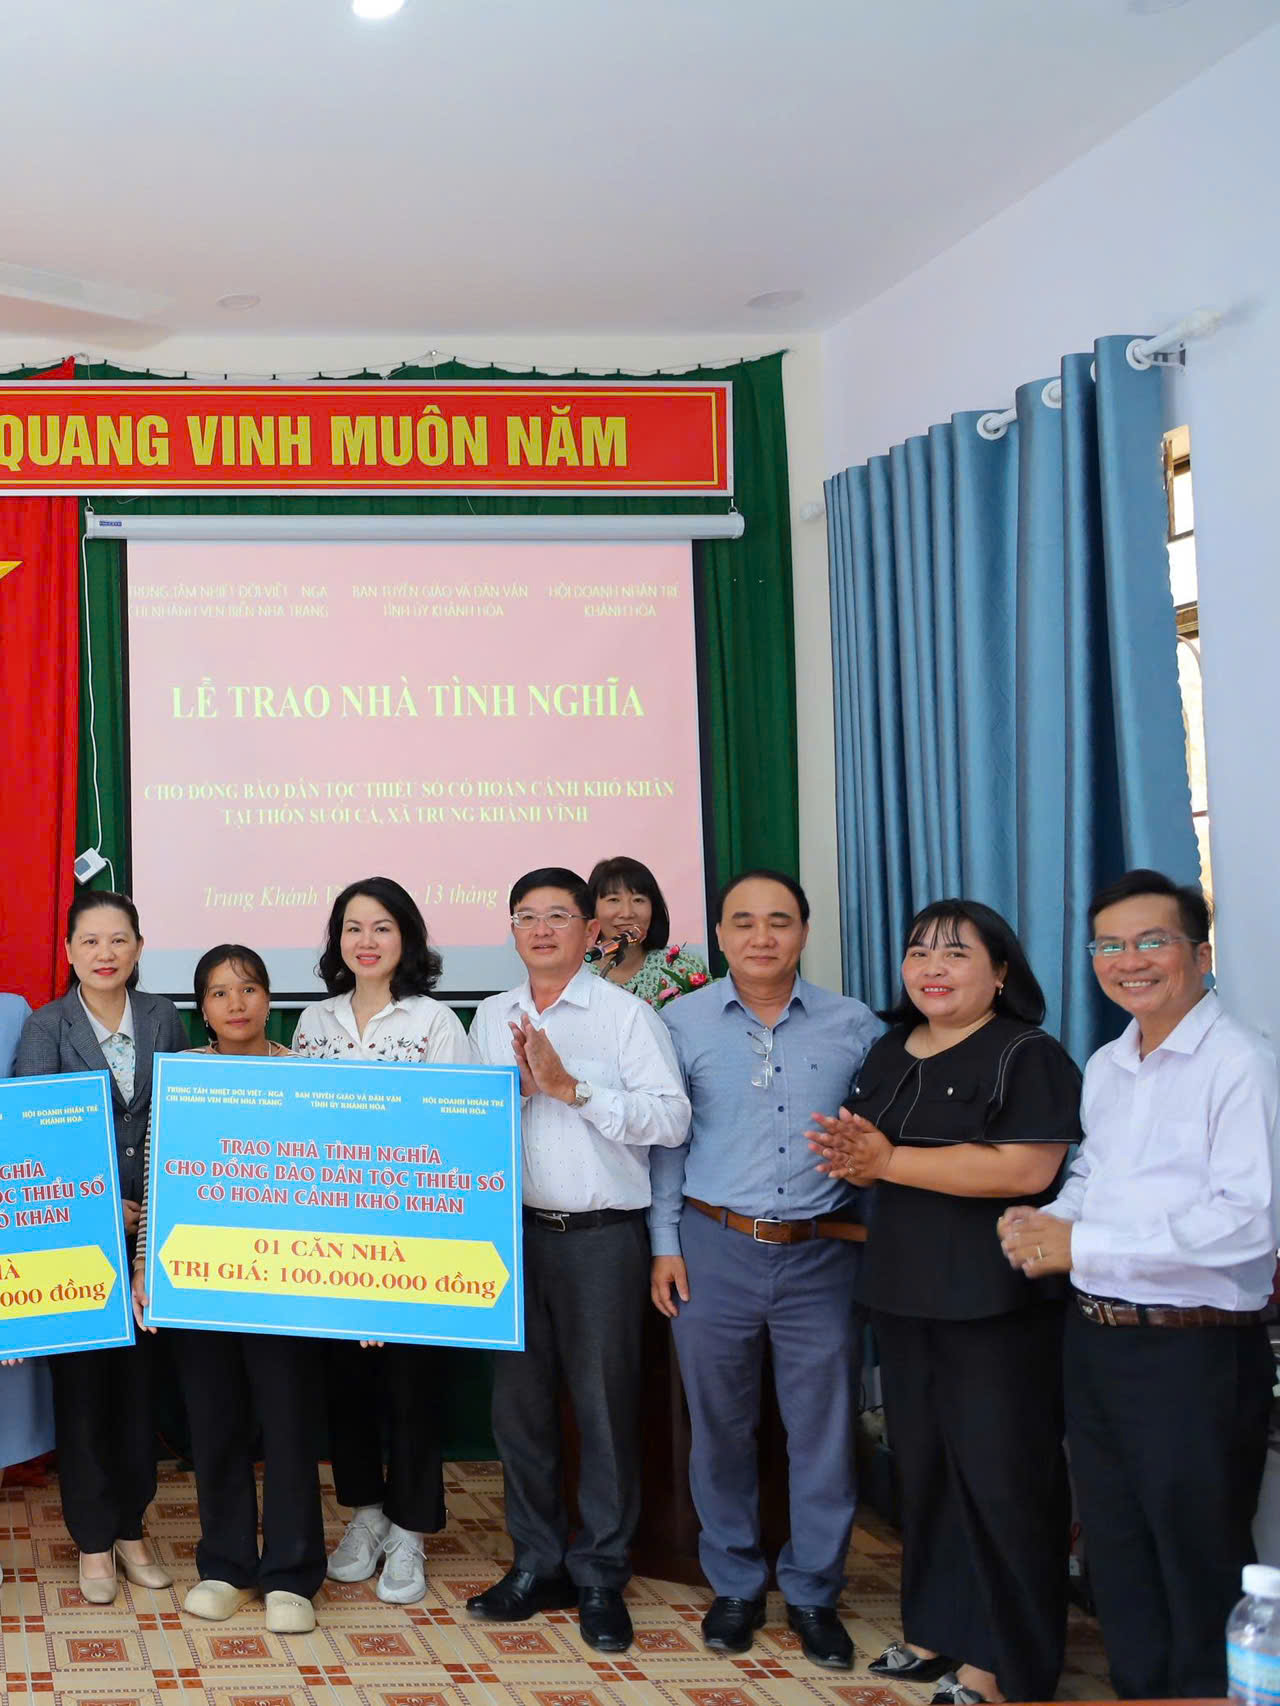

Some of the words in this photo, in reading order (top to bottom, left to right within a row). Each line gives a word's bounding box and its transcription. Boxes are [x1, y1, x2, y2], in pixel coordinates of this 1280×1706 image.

[186, 415, 311, 466] VINH
[331, 405, 488, 466] MUÔN
[507, 405, 627, 466] NĂM
[172, 676, 217, 719] LỄ
[228, 684, 331, 718] TRAO
[340, 675, 418, 718] NHÀ
[428, 675, 518, 717] TÌNH
[528, 676, 644, 717] NGHĨA
[144, 783, 183, 801] CHO
[417, 807, 475, 824] TRUNG
[203, 886, 255, 909] Trung
[261, 883, 317, 906] Khánh
[424, 884, 444, 905] 13
[449, 883, 497, 908] tháng
[220, 1139, 272, 1156] TRAO
[276, 1139, 320, 1159] NHÀ
[325, 1139, 371, 1161] TÌNH
[376, 1144, 442, 1165] NGHĨA
[22, 1177, 75, 1202] THIỂU
[79, 1174, 106, 1197] SỐ
[165, 1159, 207, 1177] CHO
[212, 1158, 269, 1179] ĐỒNG
[274, 1162, 316, 1182] BÀO
[321, 1164, 363, 1184] DÂN
[368, 1167, 410, 1189] TỘC
[415, 1168, 471, 1190] THIỂU
[477, 1170, 505, 1192] SỐ
[197, 1181, 225, 1201] CÓ
[231, 1184, 289, 1205] HOÀN
[294, 1184, 349, 1208] CẢNH
[355, 1190, 400, 1211] KHÓ
[405, 1193, 464, 1214] KHĂN
[15, 1204, 70, 1227] KHĂN
[254, 1238, 280, 1255] 01
[291, 1236, 344, 1259] CĂN
[352, 1240, 406, 1262] NHÀ
[50, 1278, 106, 1302] đồng
[168, 1260, 210, 1282] TRỊ
[218, 1259, 268, 1281] GIÁ:
[280, 1267, 427, 1291] 100.000.000
[435, 1271, 496, 1299] đồng
